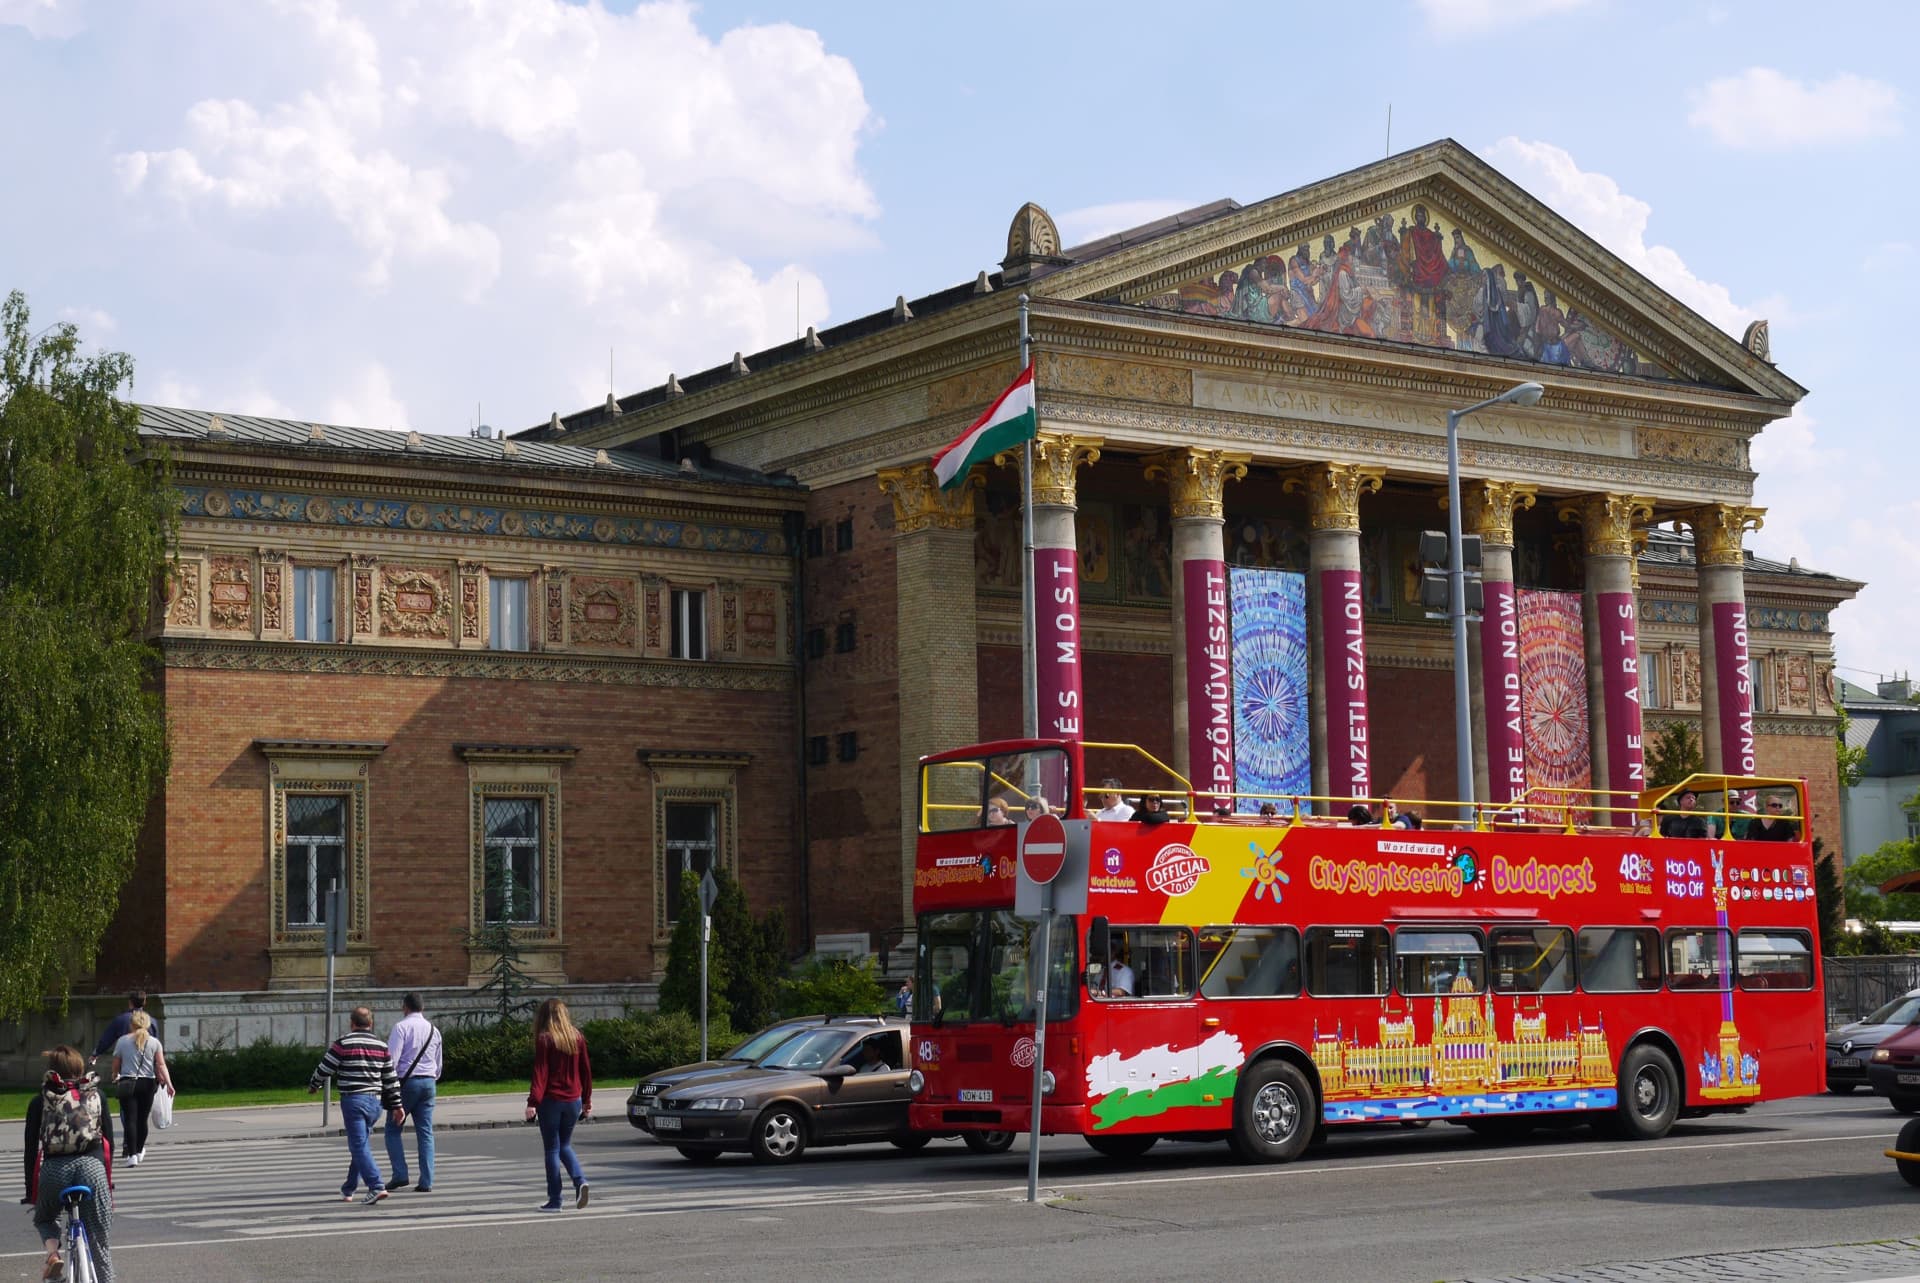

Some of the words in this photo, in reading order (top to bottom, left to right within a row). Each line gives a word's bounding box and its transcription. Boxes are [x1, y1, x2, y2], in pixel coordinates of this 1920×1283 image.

[1053, 560, 1077, 664] MOST
[1498, 593, 1518, 659] NOW
[1344, 581, 1365, 691] SZALON
[1618, 603, 1640, 703] ARTS
[1732, 612, 1750, 694] SALON
[1054, 690, 1078, 734] ÉS
[1504, 673, 1523, 734] AND
[1349, 701, 1369, 809] EMZETI
[1384, 842, 1443, 854] Worldwide
[1619, 853, 1641, 881] 48
[1666, 859, 1685, 877] Hop
[1687, 860, 1701, 876] On
[1152, 858, 1208, 886] OFFICIAL
[1171, 877, 1196, 893] TOUR
[1309, 855, 1464, 898] CitySightseeing
[1492, 854, 1596, 900] Budapest
[1667, 880, 1686, 898] Hop
[1688, 881, 1704, 897] Off
[919, 1041, 933, 1061] 48
